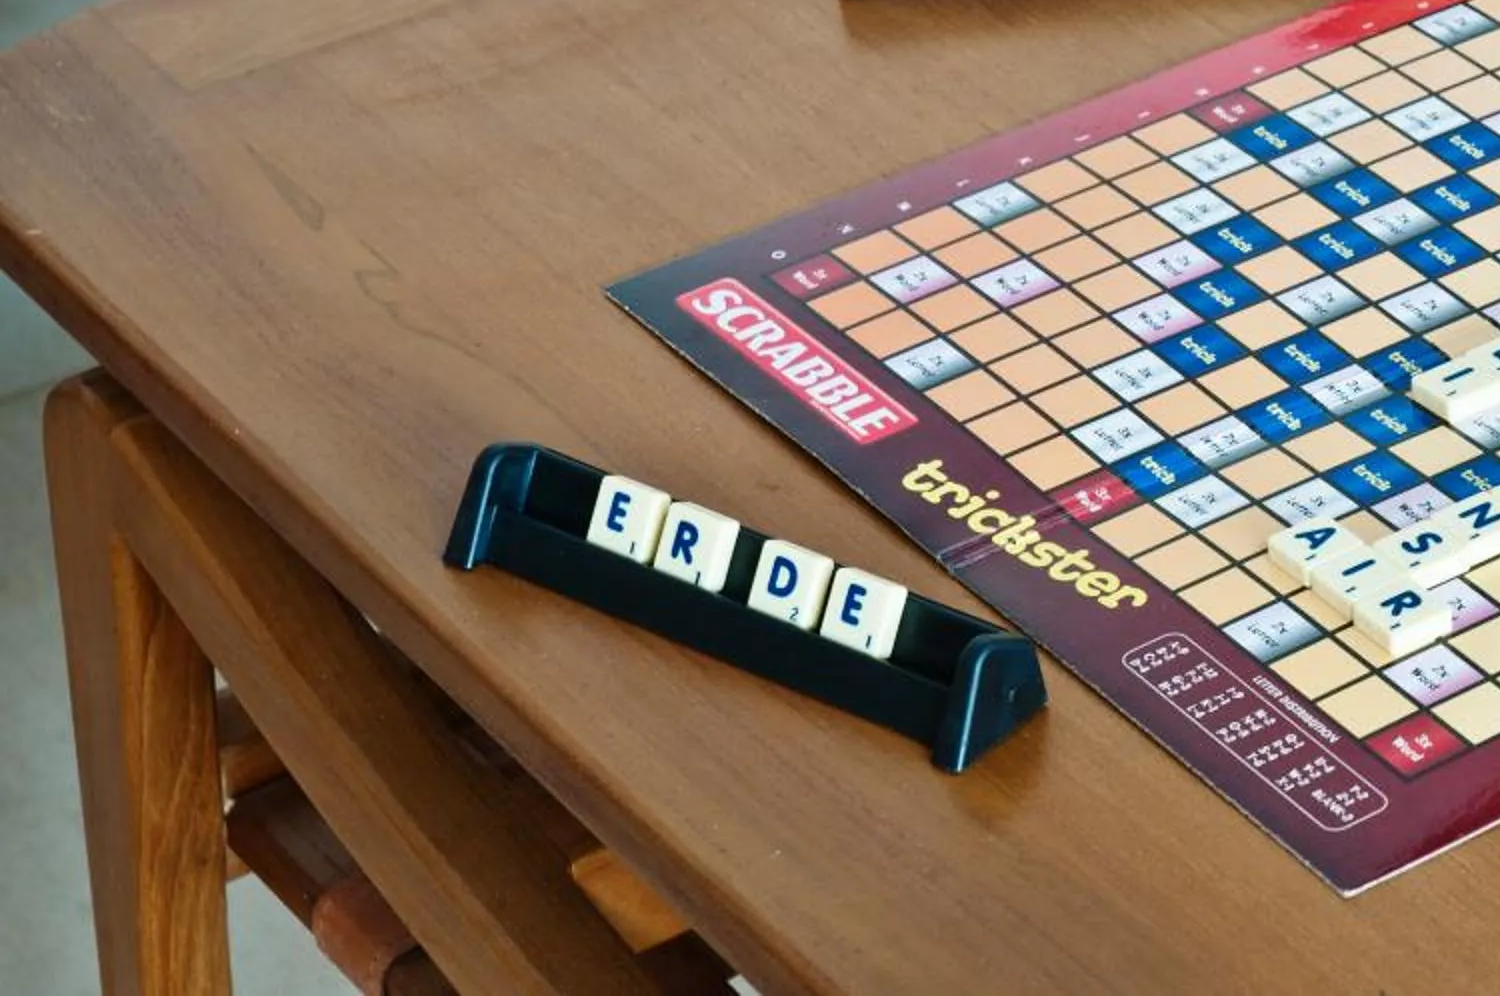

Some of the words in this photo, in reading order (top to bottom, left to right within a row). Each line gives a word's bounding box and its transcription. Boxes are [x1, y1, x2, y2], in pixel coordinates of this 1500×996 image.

[1251, 126, 1289, 149] trick
[1449, 134, 1484, 159] trick
[1335, 180, 1370, 206] trick
[1434, 185, 1470, 211] trick
[1217, 227, 1252, 253] trick
[1318, 233, 1354, 259] trick
[1419, 239, 1456, 265] trick
[1199, 281, 1234, 307] trick
[1180, 336, 1216, 364] trick
[1283, 343, 1320, 372] trick
[691, 289, 901, 438] SCRABBLE
[1266, 402, 1301, 430] trick
[1370, 408, 1407, 434] trick
[1140, 455, 1175, 484] trick
[1352, 463, 1390, 491] trick
[1459, 470, 1493, 491] tric
[901, 458, 1150, 612] trickster
